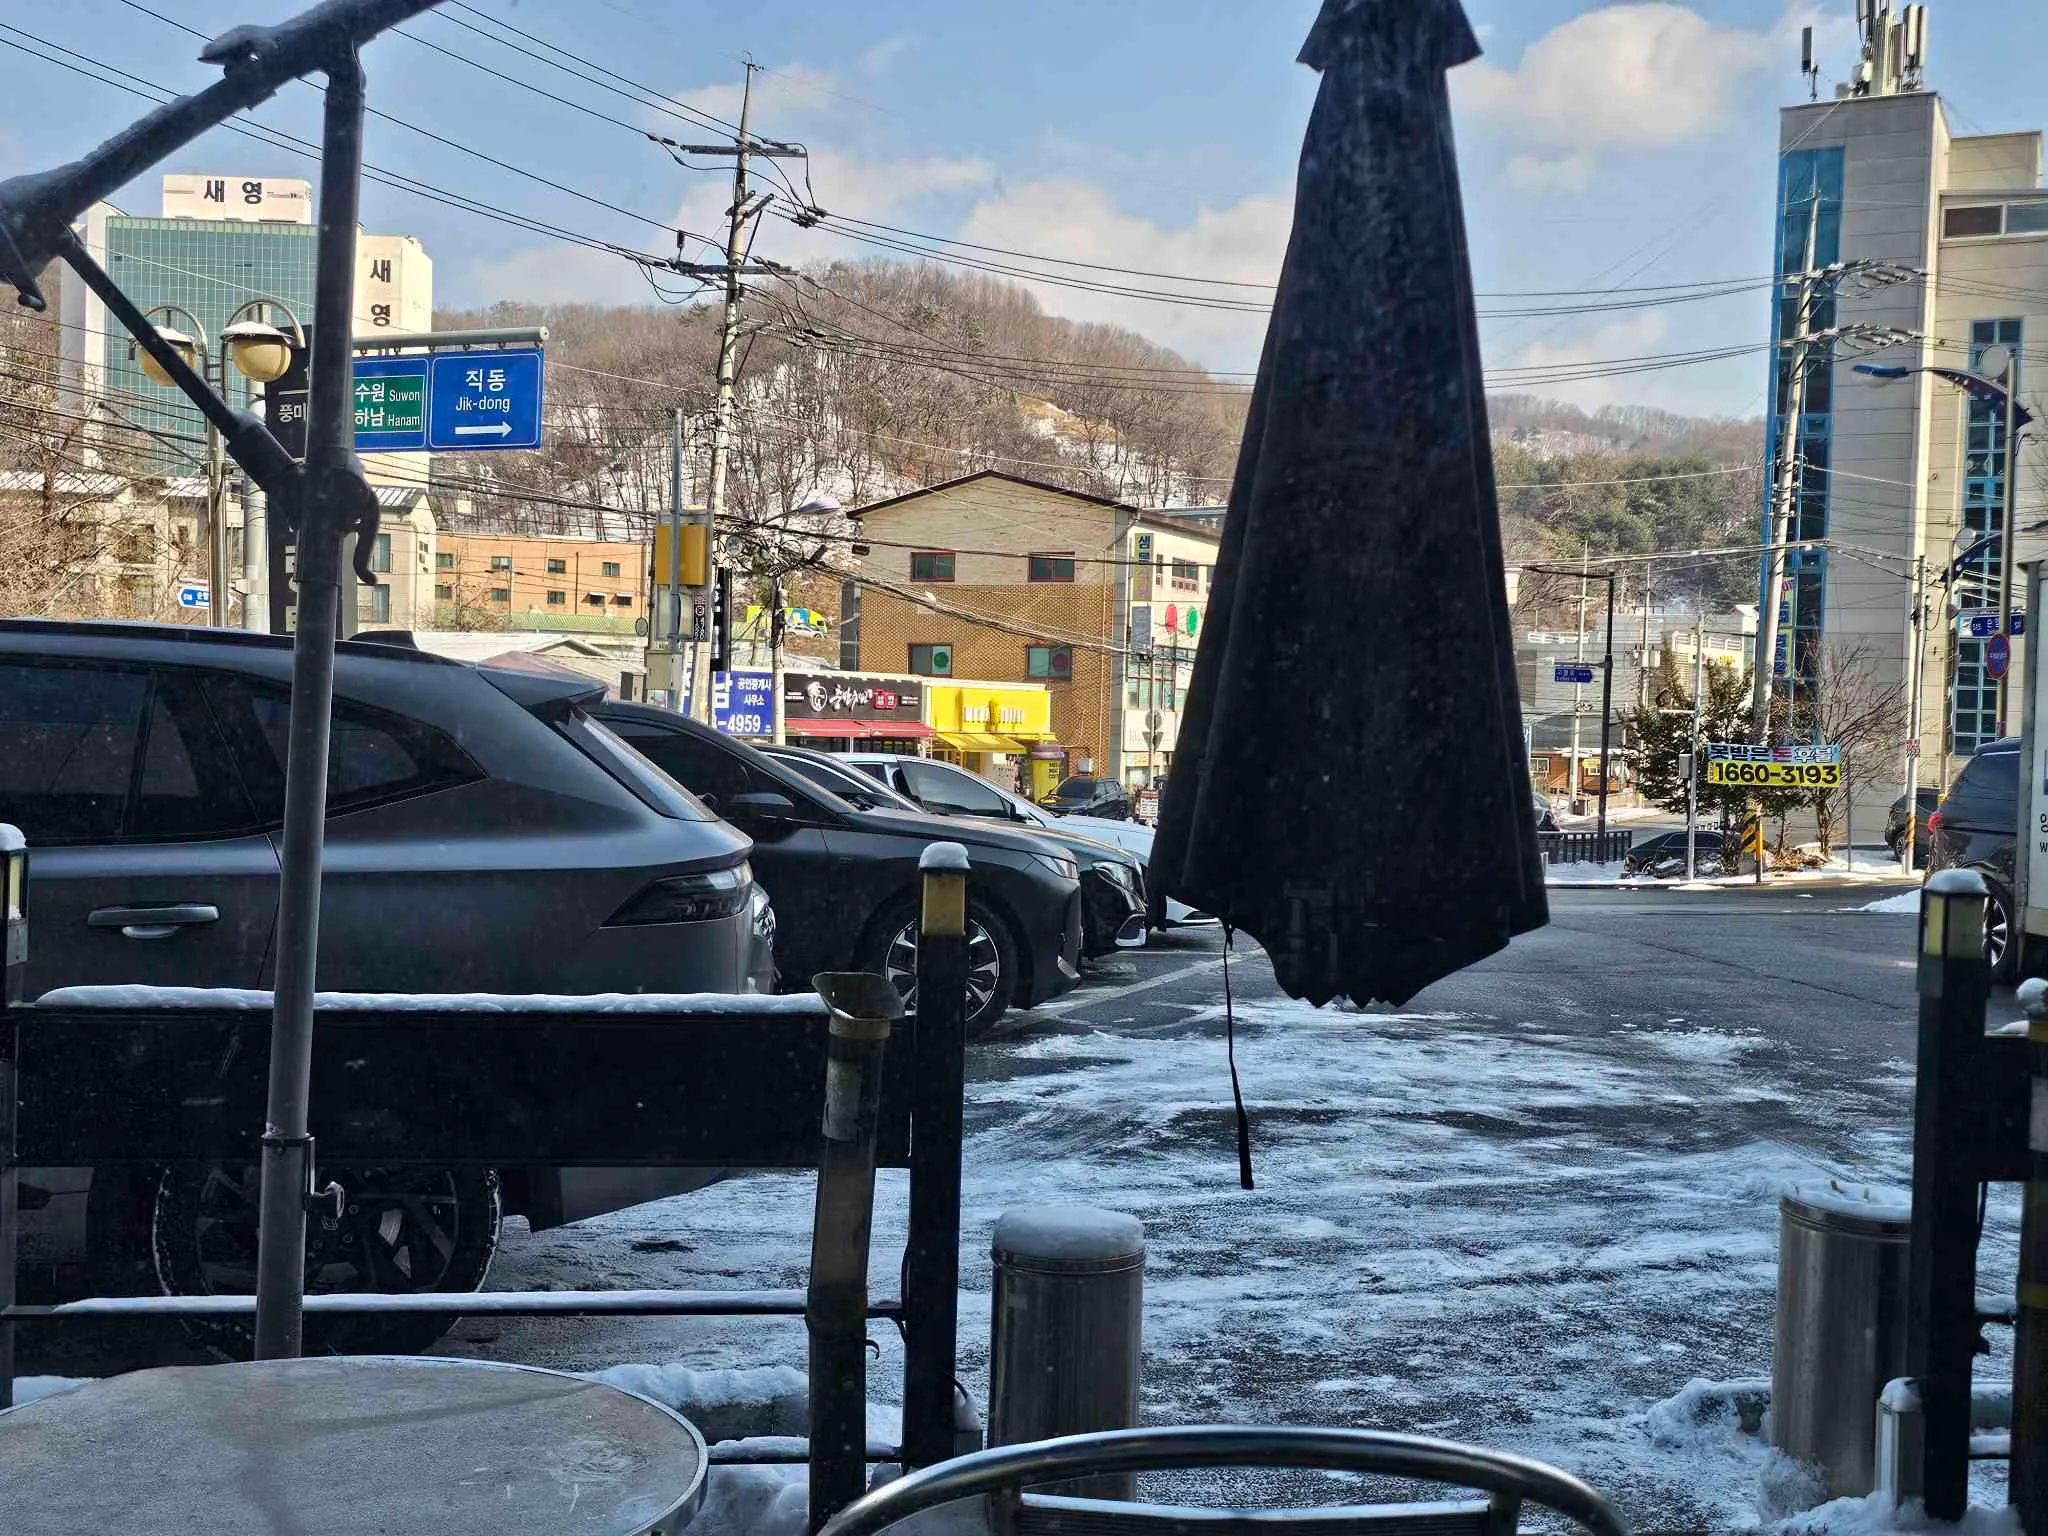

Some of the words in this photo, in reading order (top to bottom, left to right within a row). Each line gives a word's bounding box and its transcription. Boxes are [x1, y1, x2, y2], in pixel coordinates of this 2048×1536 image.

[465, 368, 507, 392] 직동
[355, 382, 385, 402] 수원
[389, 390, 420, 401] Suwon
[456, 396, 510, 413] Jik-dong
[354, 407, 385, 427] 하남
[388, 414, 420, 427] Hanam
[737, 678, 772, 690] 공인중개사
[743, 694, 765, 706] 사무소
[1715, 762, 1838, 785] 1660-3193
